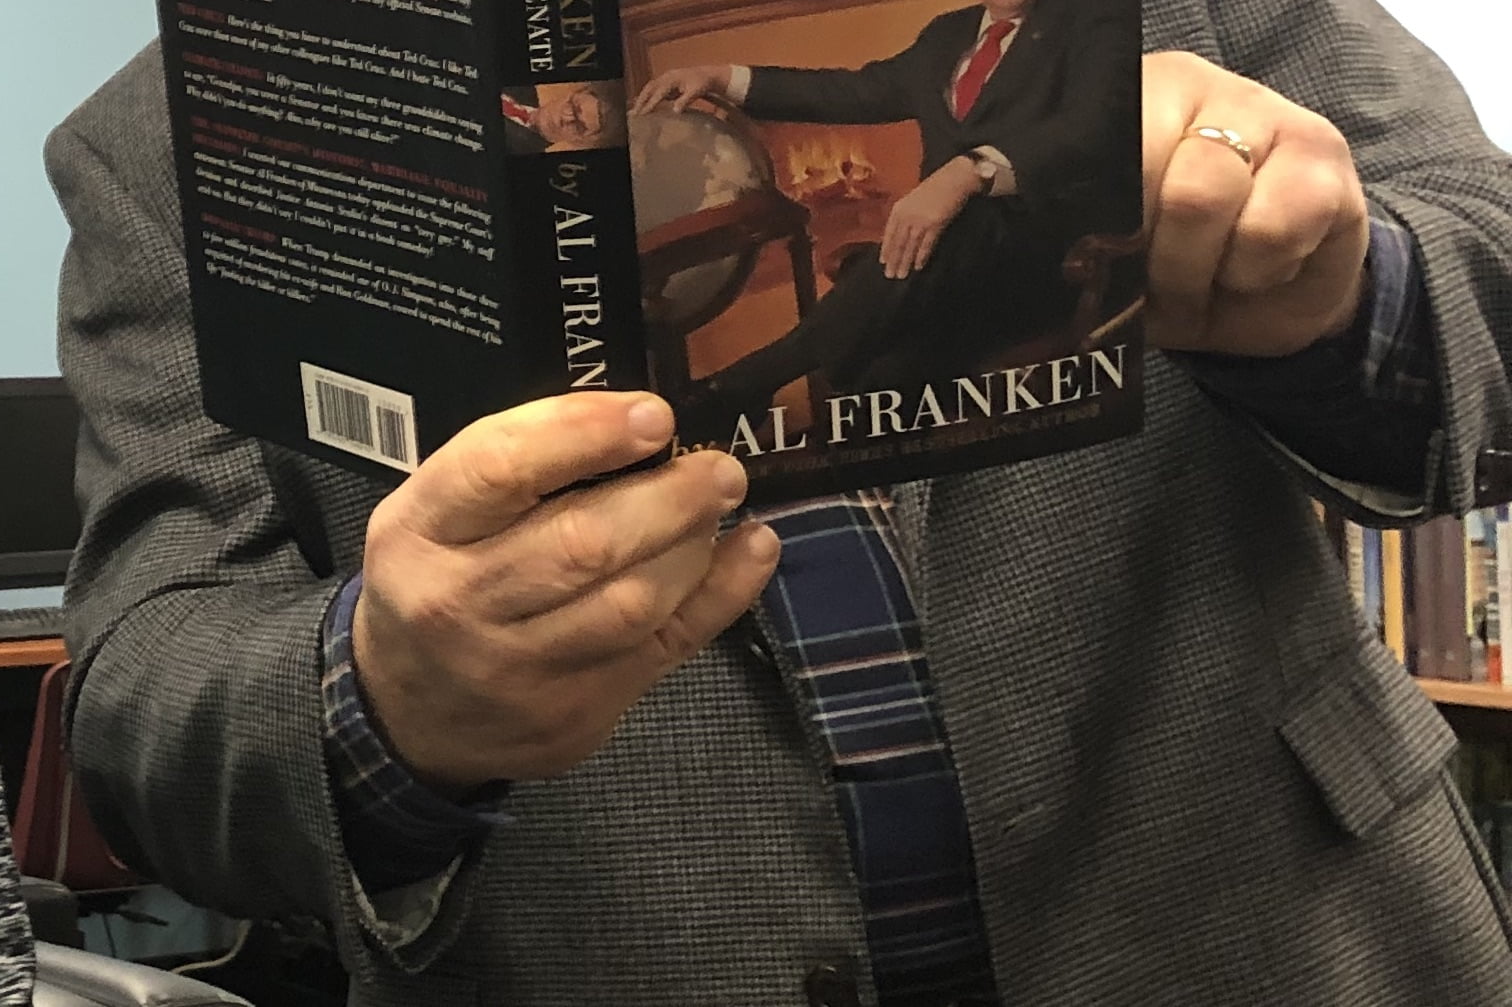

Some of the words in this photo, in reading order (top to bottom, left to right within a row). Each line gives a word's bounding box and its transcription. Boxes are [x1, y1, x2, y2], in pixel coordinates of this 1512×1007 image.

[549, 162, 586, 198] by
[554, 205, 597, 262] AL
[560, 274, 609, 389] FRAN
[727, 405, 807, 458] AL
[824, 344, 1127, 445] FRANKEN
